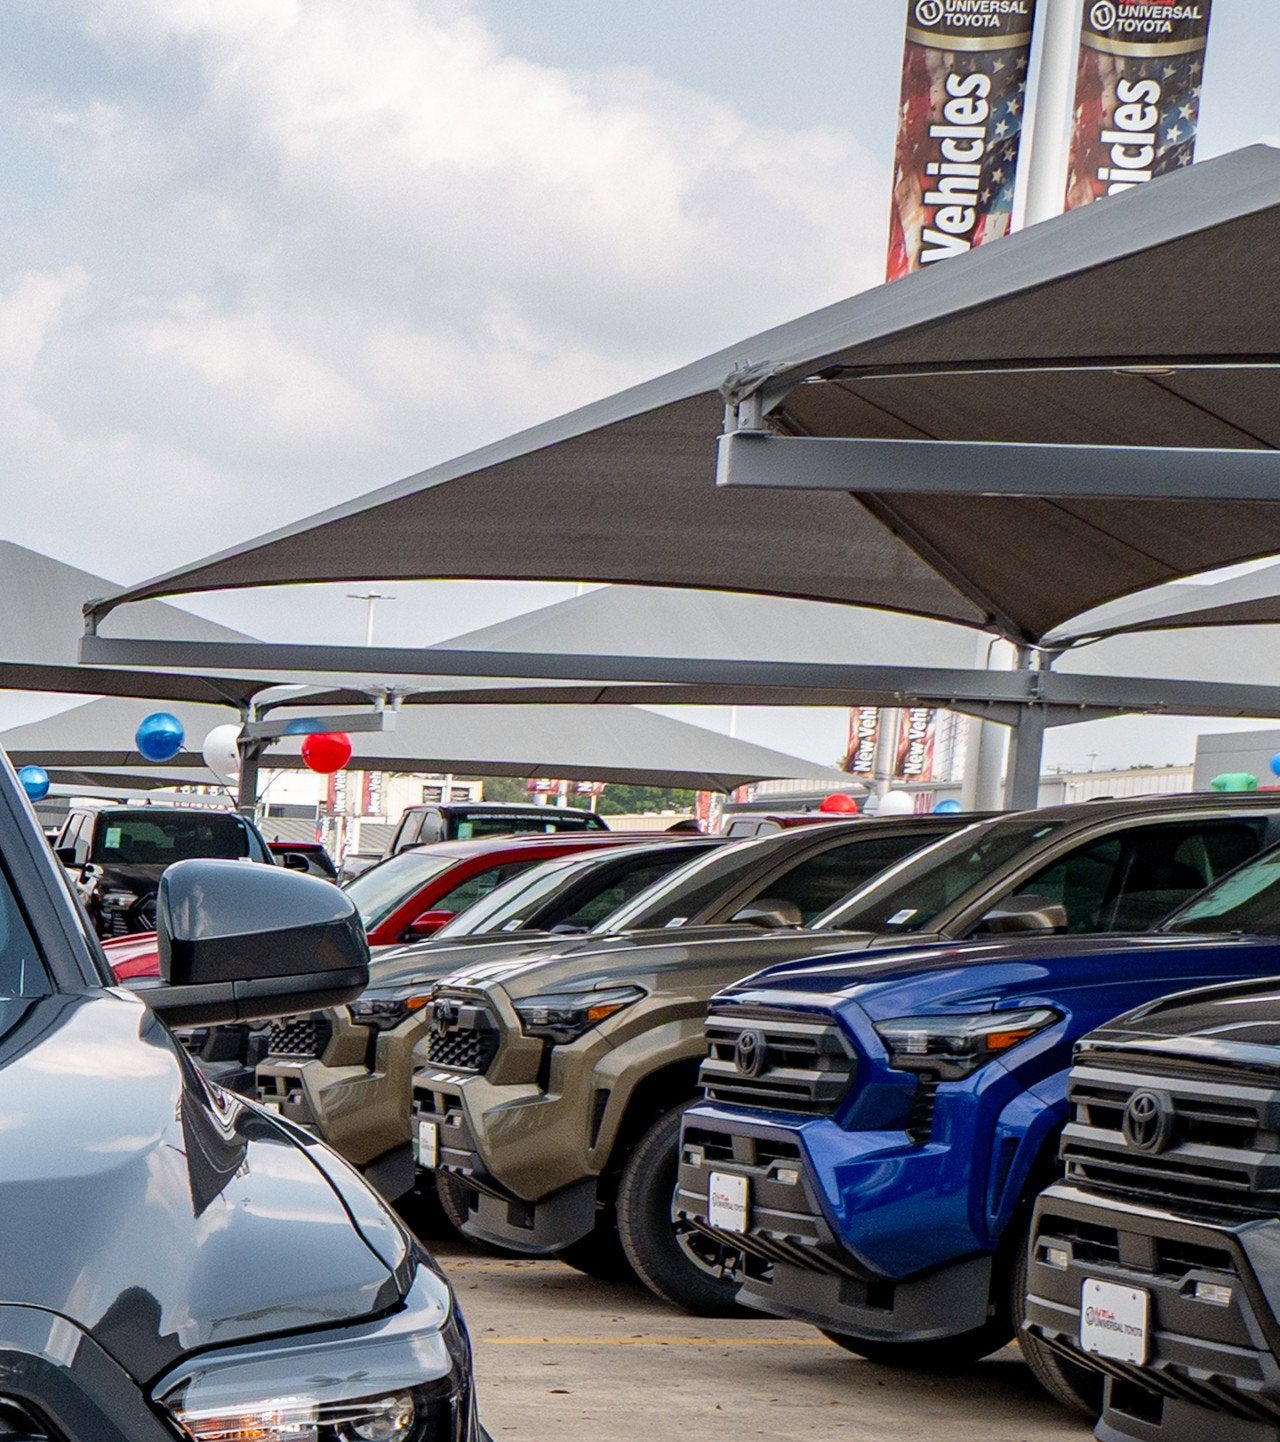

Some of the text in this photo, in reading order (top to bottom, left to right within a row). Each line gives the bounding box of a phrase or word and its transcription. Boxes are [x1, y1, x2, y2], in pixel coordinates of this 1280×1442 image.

[945, 0, 1028, 14] UNIVERSAL
[1118, 5, 1203, 19] UNIVERSAL
[944, 13, 1000, 27] TOYOTA
[1116, 19, 1172, 33] TOYOTA
[920, 73, 991, 264] Vehicles
[854, 740, 875, 772] New
[904, 742, 926, 774] New
